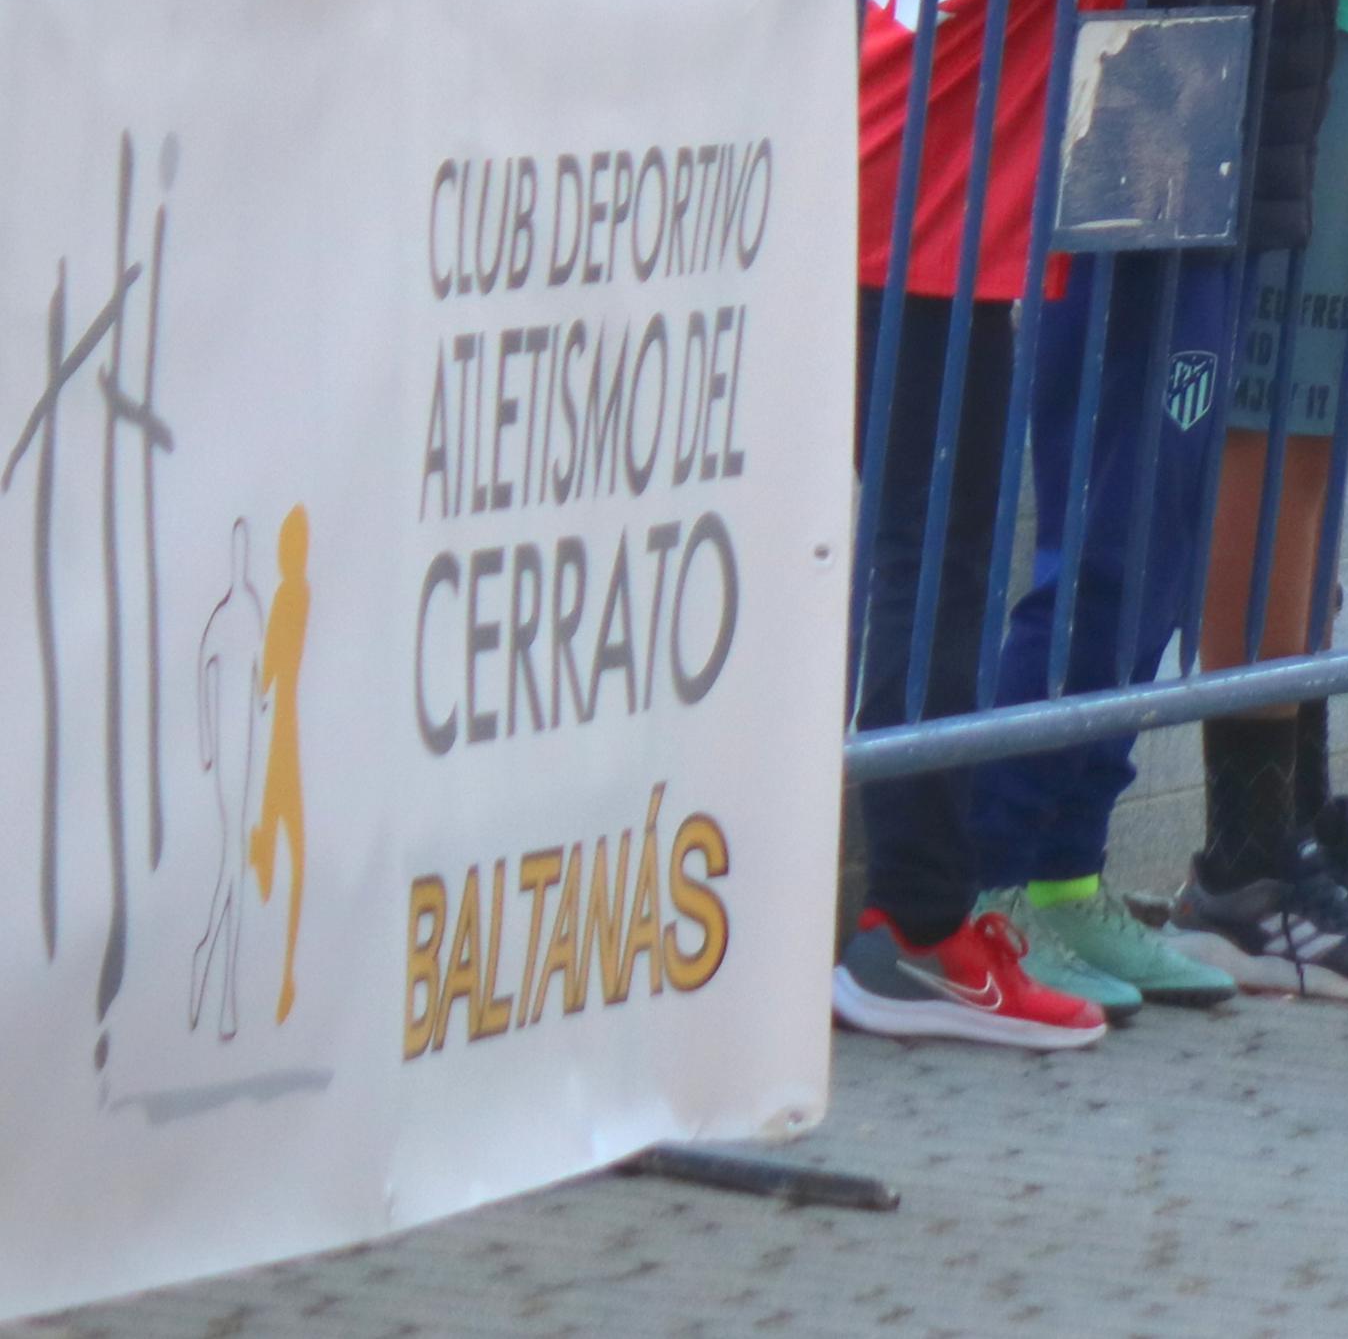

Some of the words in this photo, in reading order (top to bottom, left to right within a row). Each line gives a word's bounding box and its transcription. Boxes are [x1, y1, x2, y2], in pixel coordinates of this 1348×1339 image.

[428, 155, 539, 302] CLUB
[546, 135, 774, 285] DEPORTIVO
[418, 310, 669, 524] ATLETISMO
[672, 303, 747, 489] DEL
[415, 509, 740, 757] CERRATO
[403, 779, 730, 1063] BALTANÁS
